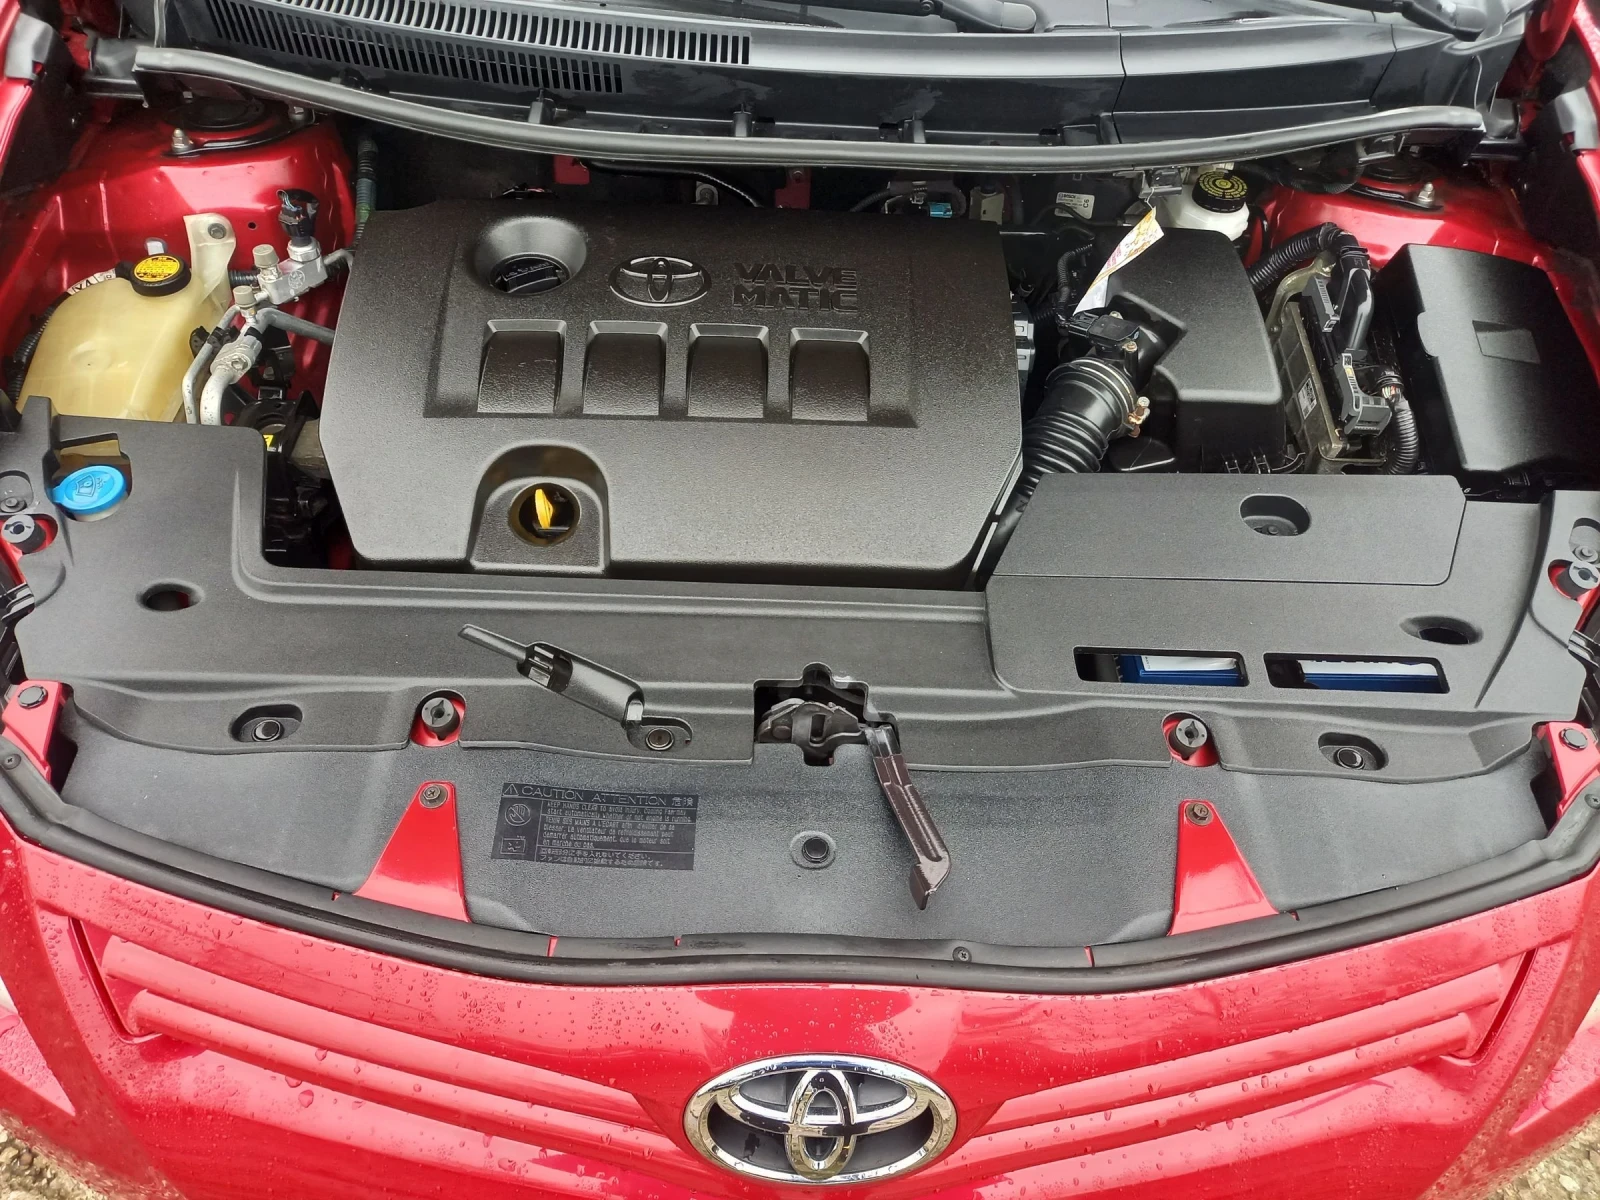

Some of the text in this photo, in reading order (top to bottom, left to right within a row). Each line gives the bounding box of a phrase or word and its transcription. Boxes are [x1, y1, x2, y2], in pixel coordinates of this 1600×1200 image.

[733, 262, 858, 290] VALVE
[732, 284, 859, 314] MATIC
[521, 786, 667, 806] CAUTION ATTENTION
